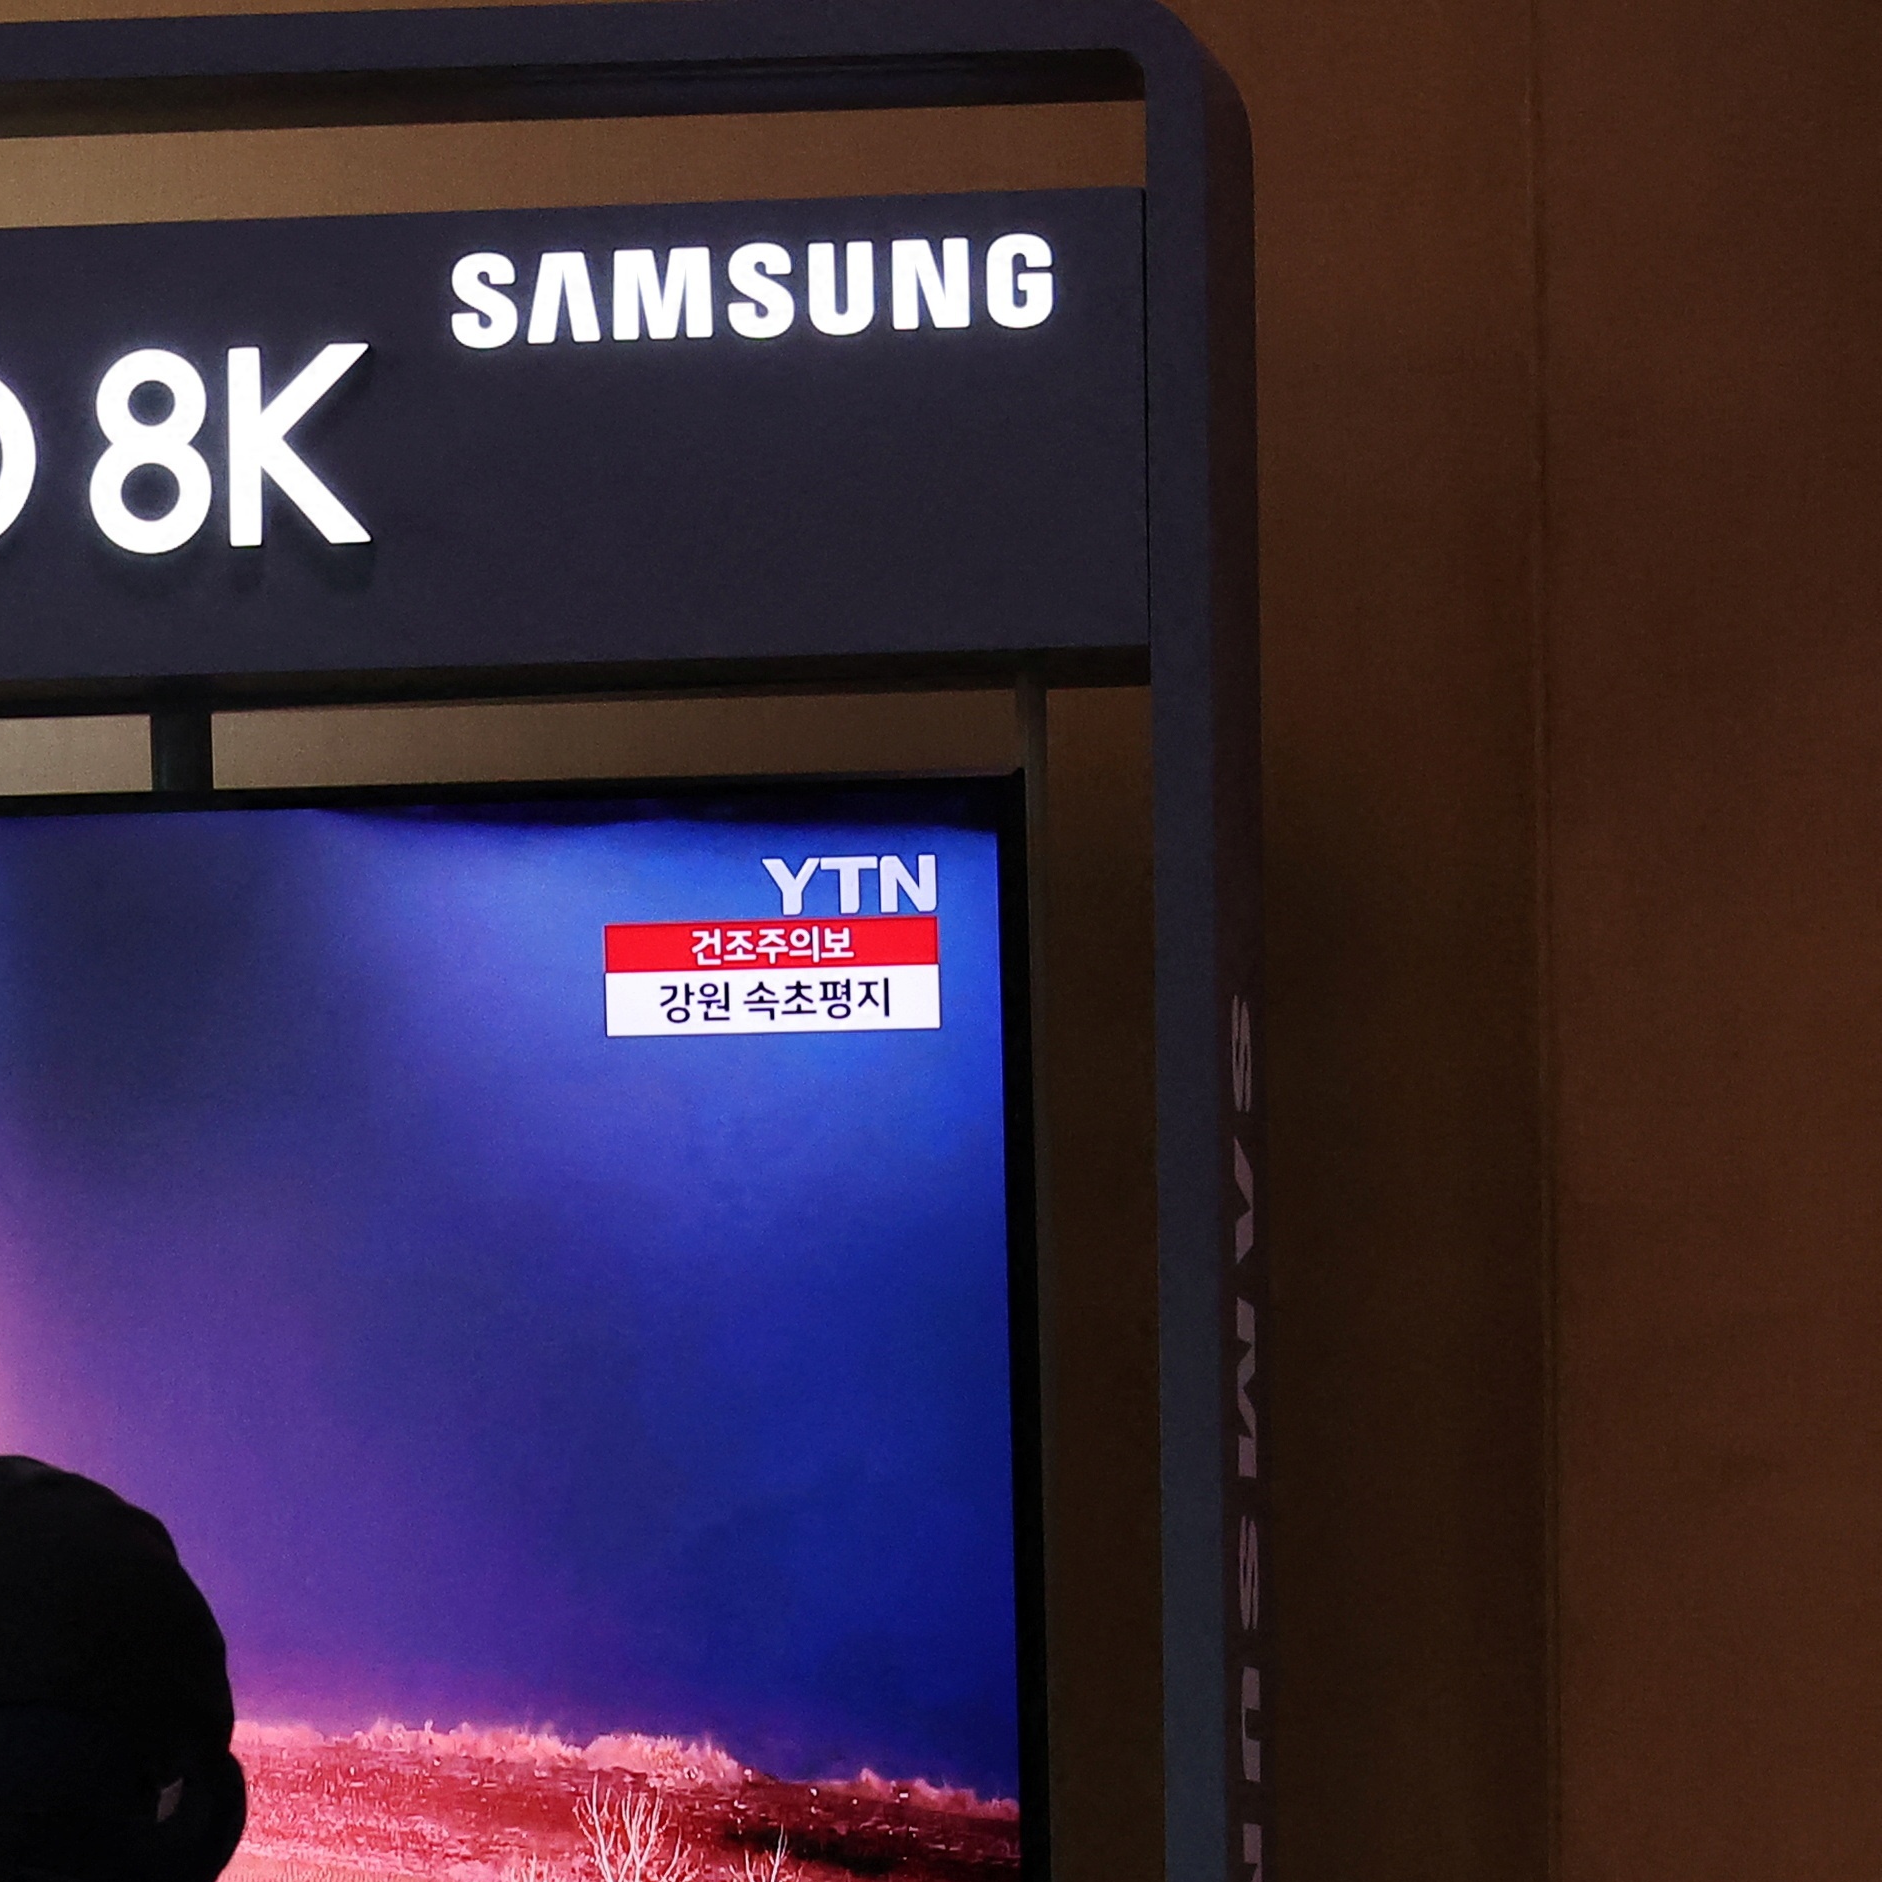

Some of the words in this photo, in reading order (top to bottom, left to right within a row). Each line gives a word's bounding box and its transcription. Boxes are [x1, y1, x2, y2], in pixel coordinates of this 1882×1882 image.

[451, 232, 1054, 349] SAMSUNG
[87, 341, 372, 554] 8K
[761, 854, 937, 916] YTN
[691, 925, 855, 966] 건조주의보
[659, 981, 731, 1024] 강원
[742, 976, 891, 1021] 속초평지
